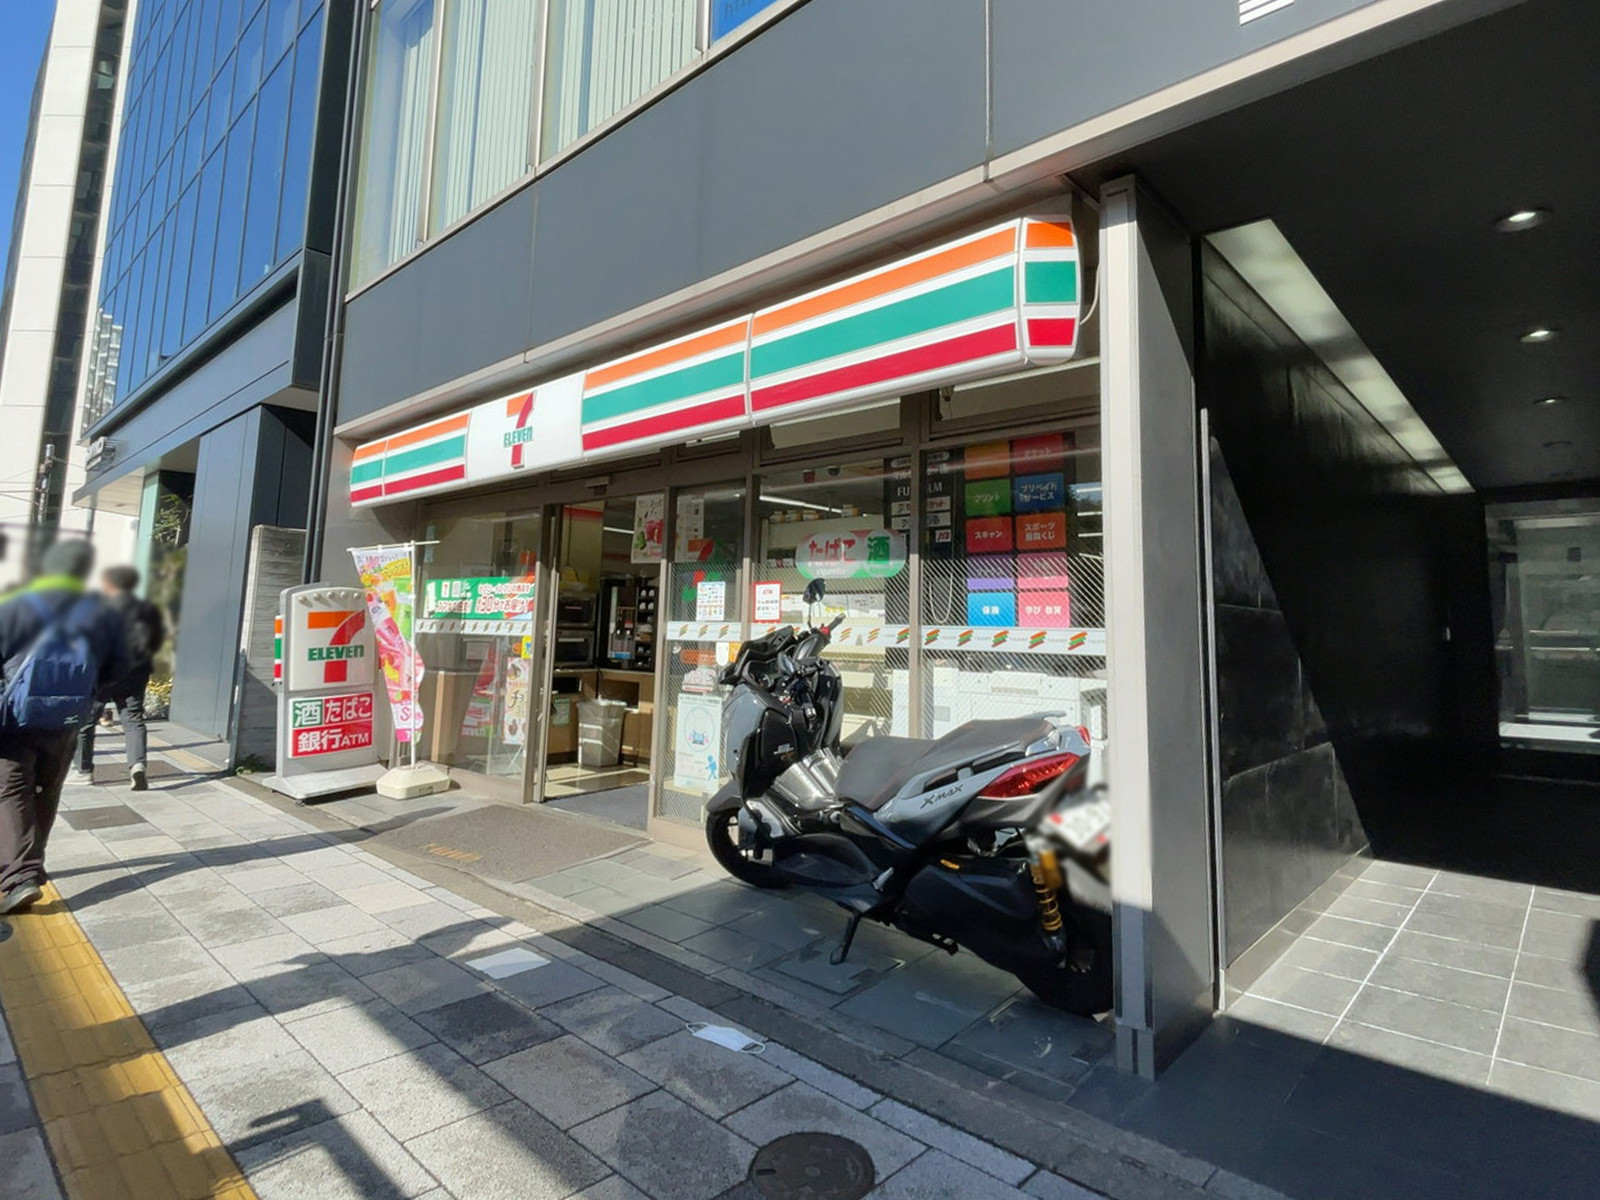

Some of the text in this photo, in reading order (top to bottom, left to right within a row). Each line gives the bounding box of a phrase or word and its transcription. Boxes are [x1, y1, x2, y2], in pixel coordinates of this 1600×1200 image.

[506, 391, 537, 470] 7
[808, 536, 857, 564] たばこ
[307, 609, 366, 684] 7
[294, 701, 322, 727] 酒
[325, 697, 372, 723] たばこ
